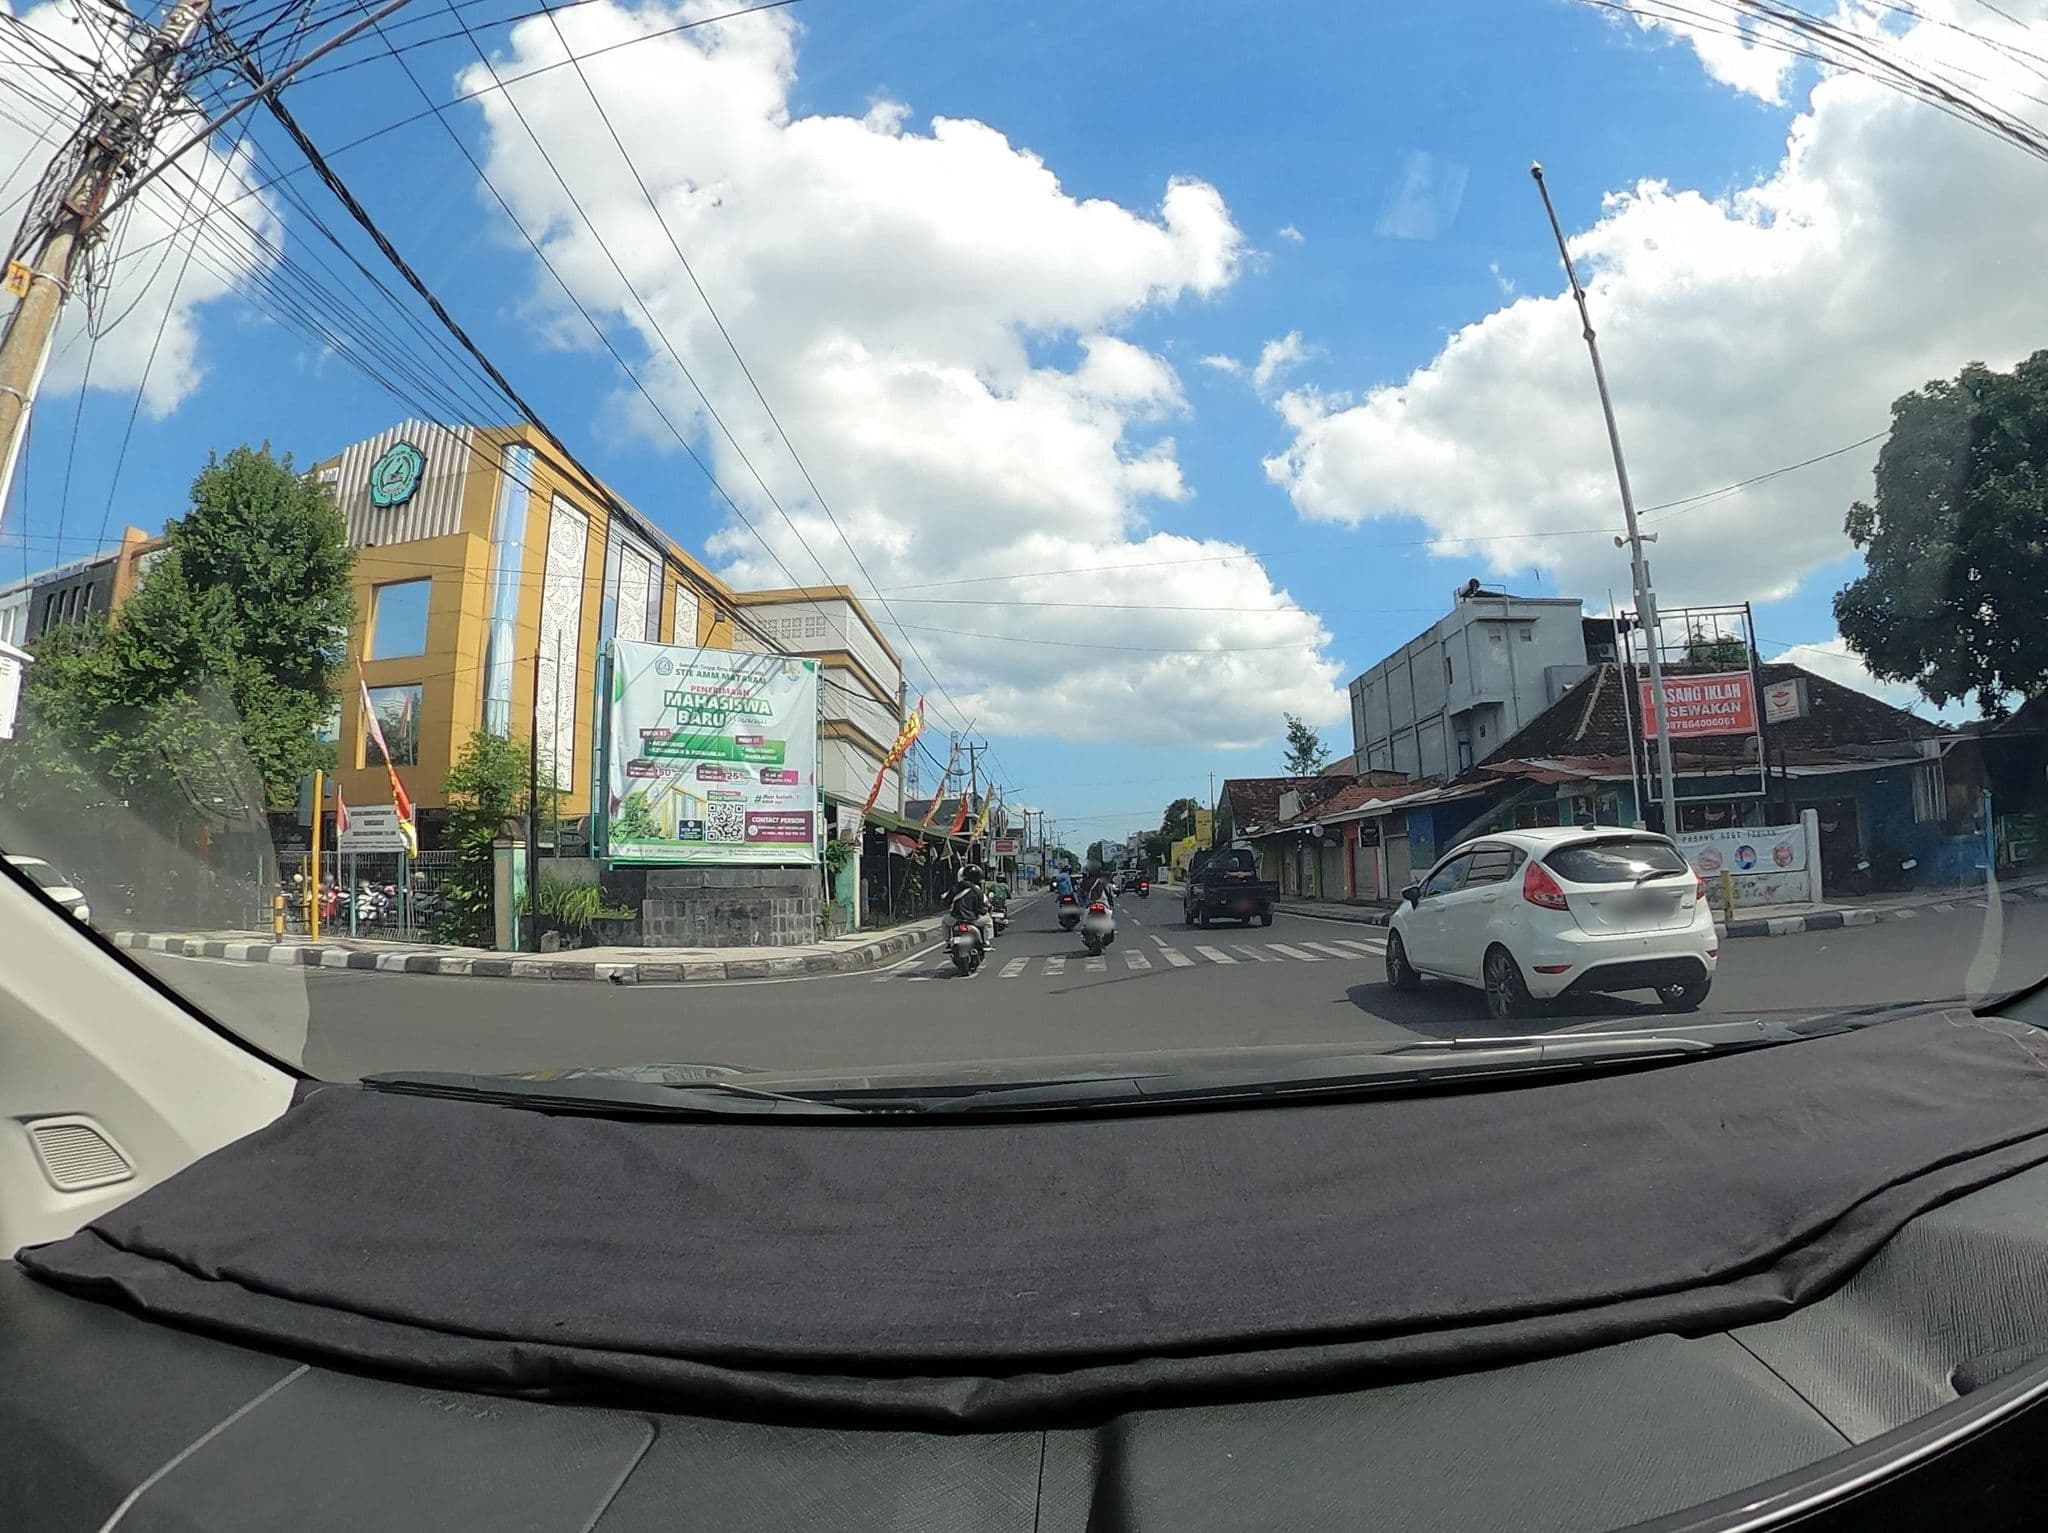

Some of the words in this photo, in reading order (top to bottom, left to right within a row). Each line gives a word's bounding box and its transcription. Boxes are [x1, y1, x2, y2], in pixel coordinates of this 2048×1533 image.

[696, 670, 719, 680] AMM
[721, 673, 767, 685] MATARAM
[690, 685, 751, 696] PENERIMAAN
[1650, 686, 1702, 705] SANG
[1704, 683, 1741, 700] IKLAN
[665, 691, 772, 714] MAHASISWA
[1665, 702, 1741, 718] ISEWAKAN
[678, 709, 726, 727] BARU
